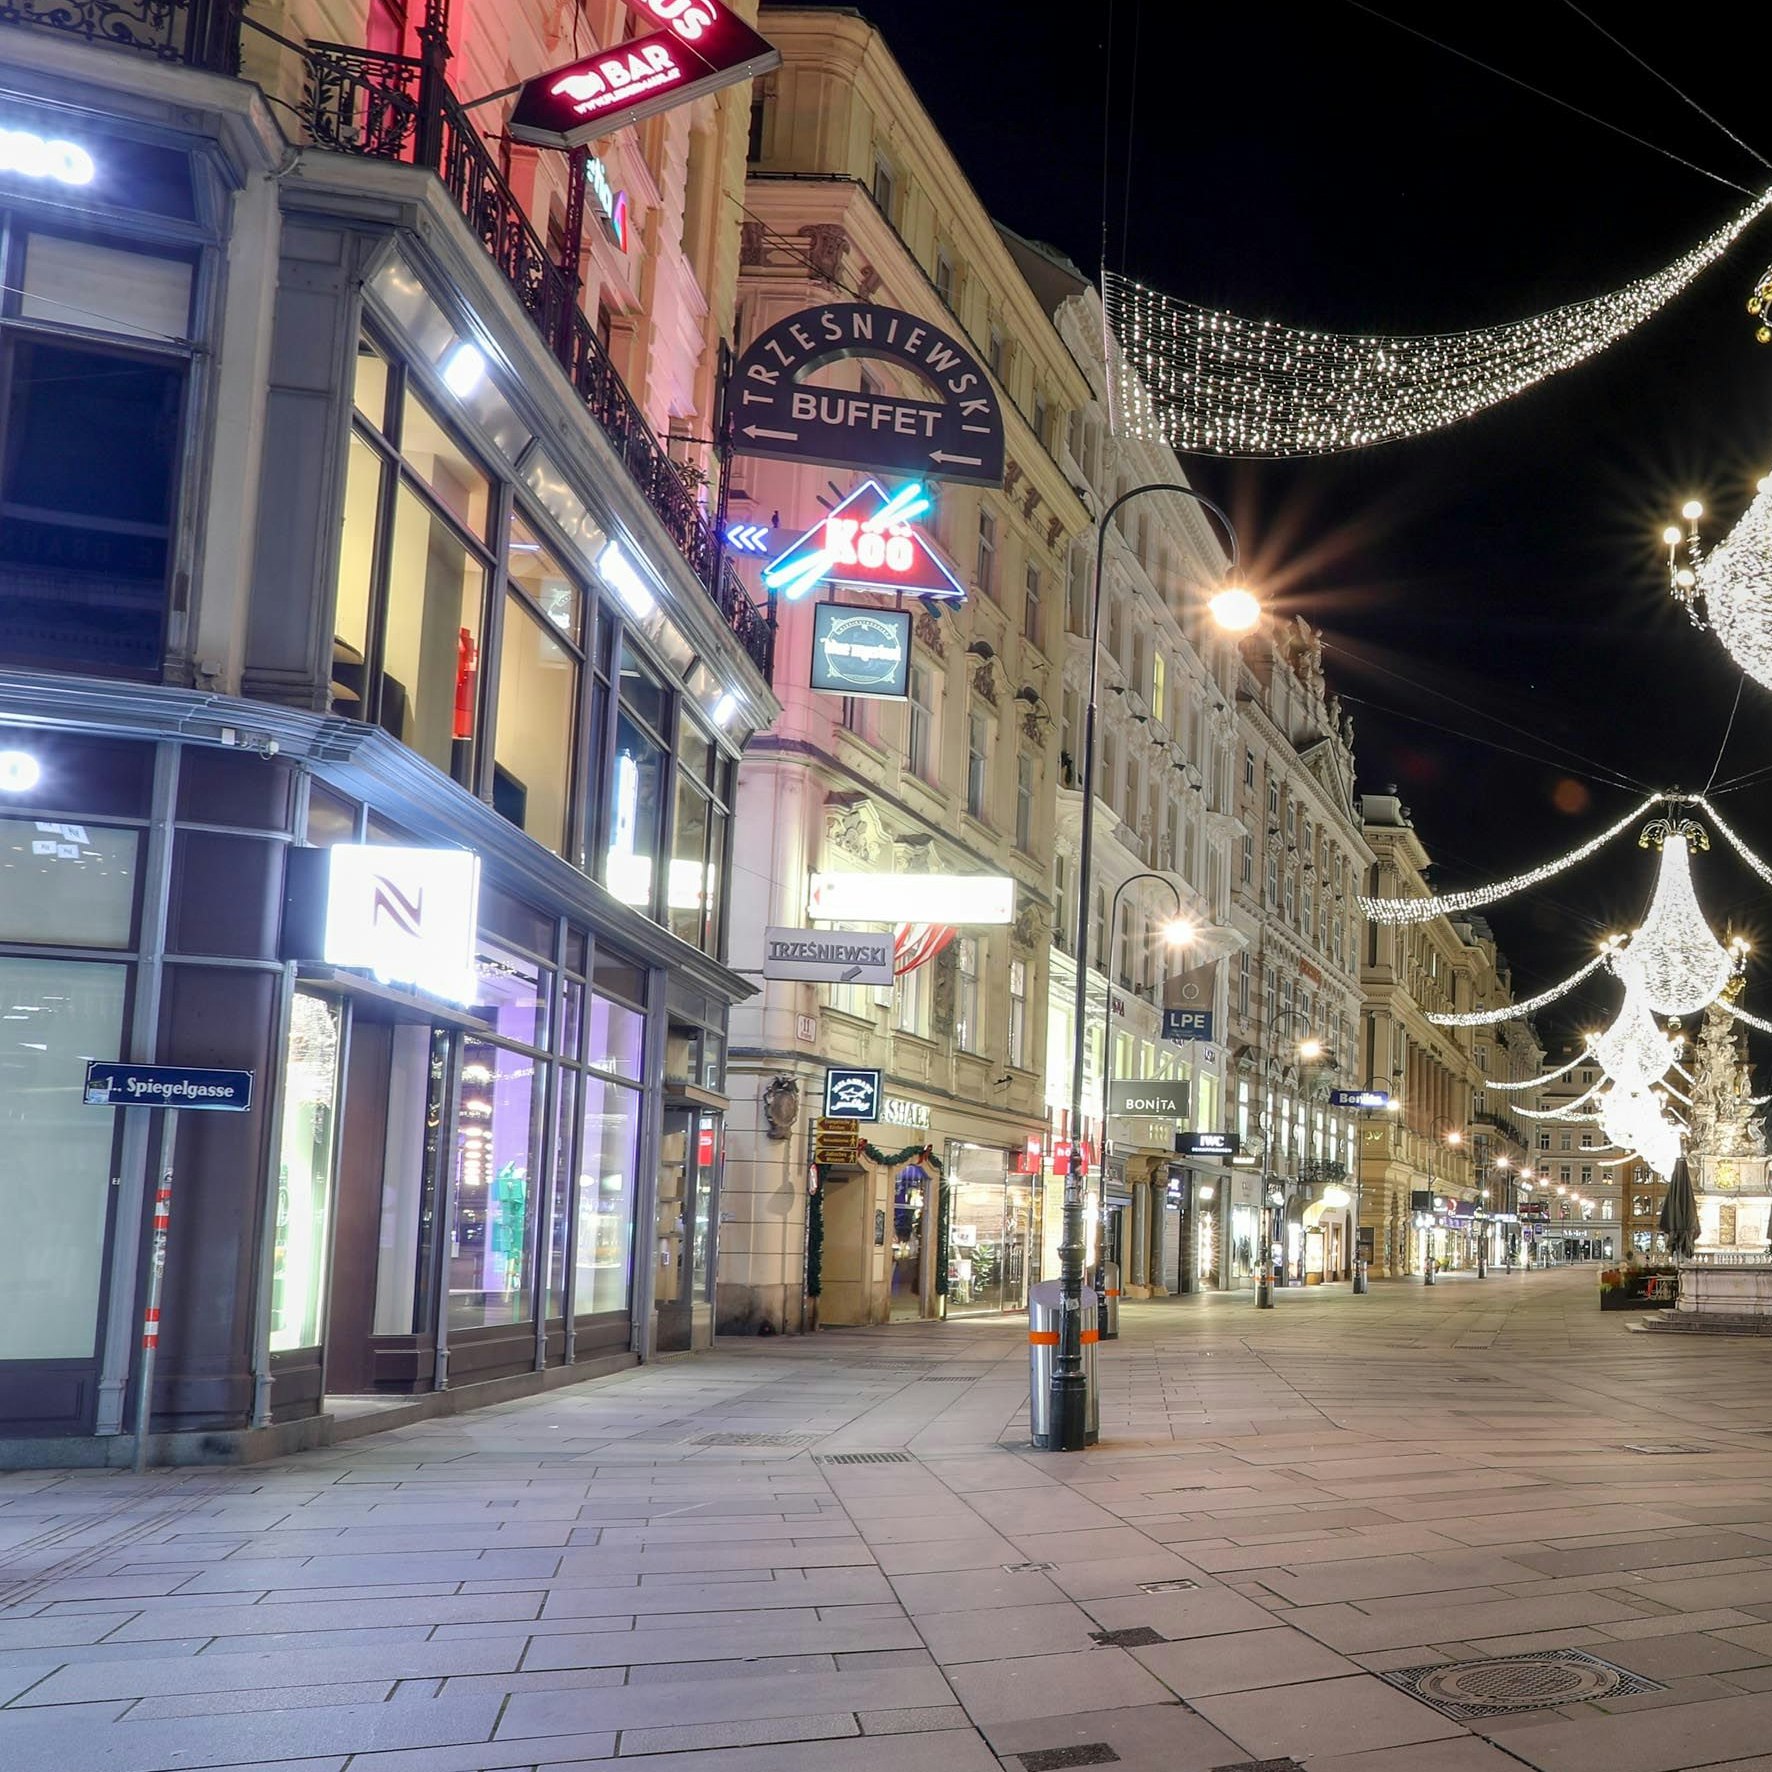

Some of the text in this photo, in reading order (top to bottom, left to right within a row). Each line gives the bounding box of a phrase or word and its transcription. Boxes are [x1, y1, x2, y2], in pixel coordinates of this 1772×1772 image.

[600, 45, 675, 87] BAR
[792, 392, 942, 437] BUFFET
[769, 940, 886, 966] TRZEŚNIEWSKI
[1170, 1013, 1206, 1029] LPE
[127, 1077, 235, 1098] Spiegelgasse
[1200, 1135, 1225, 1147] IWC
